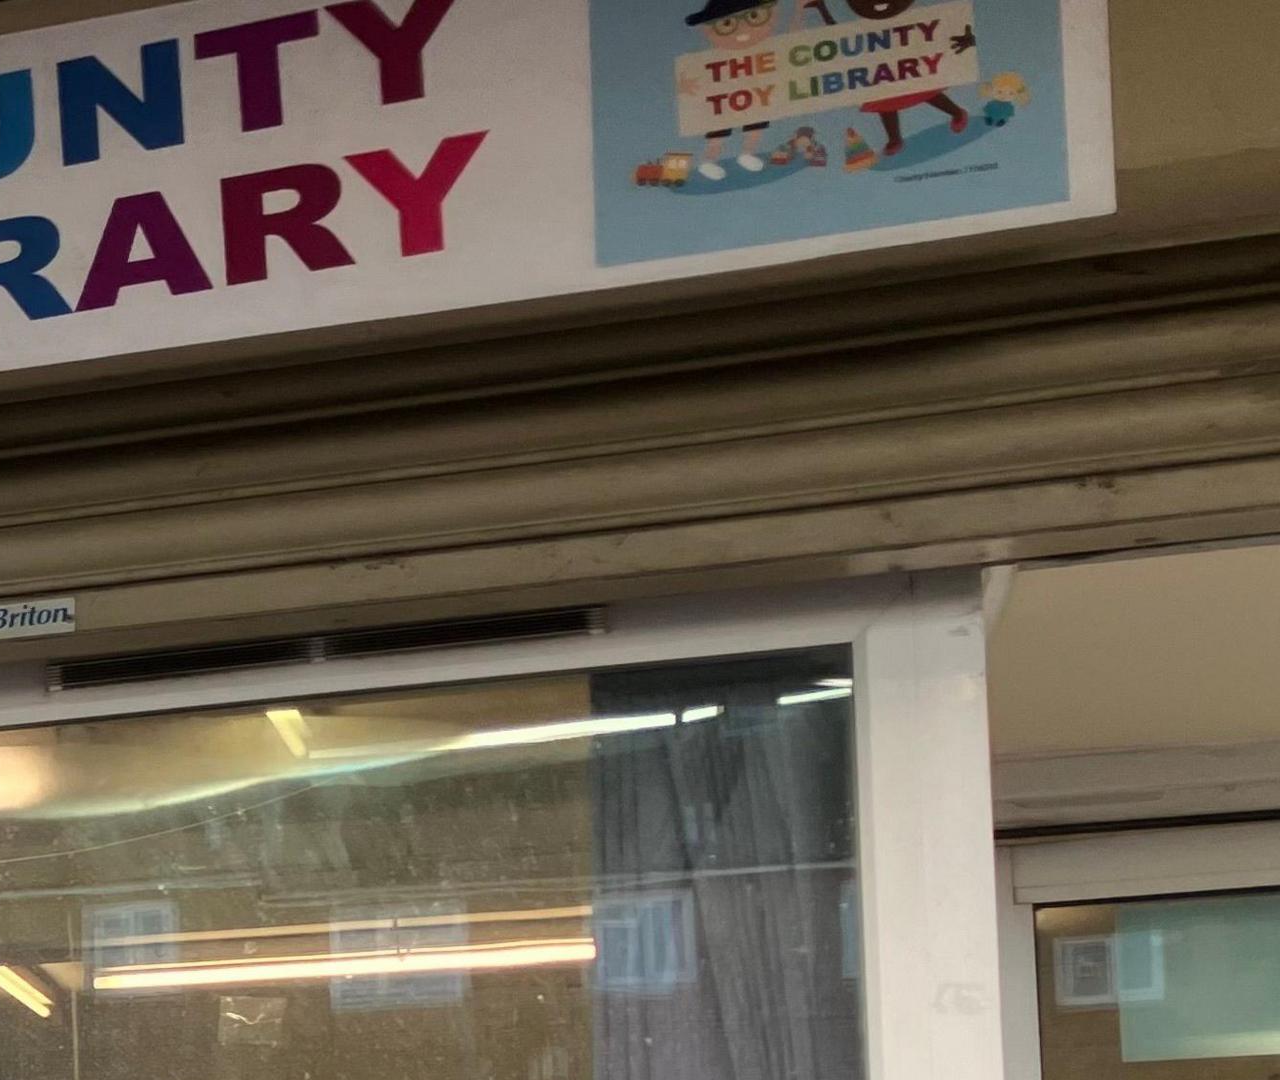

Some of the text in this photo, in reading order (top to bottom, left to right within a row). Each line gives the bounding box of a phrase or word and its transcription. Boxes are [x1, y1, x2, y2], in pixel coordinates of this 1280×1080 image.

[705, 18, 941, 84] THE COUNTY
[706, 51, 944, 116] TOY LIBRARY
